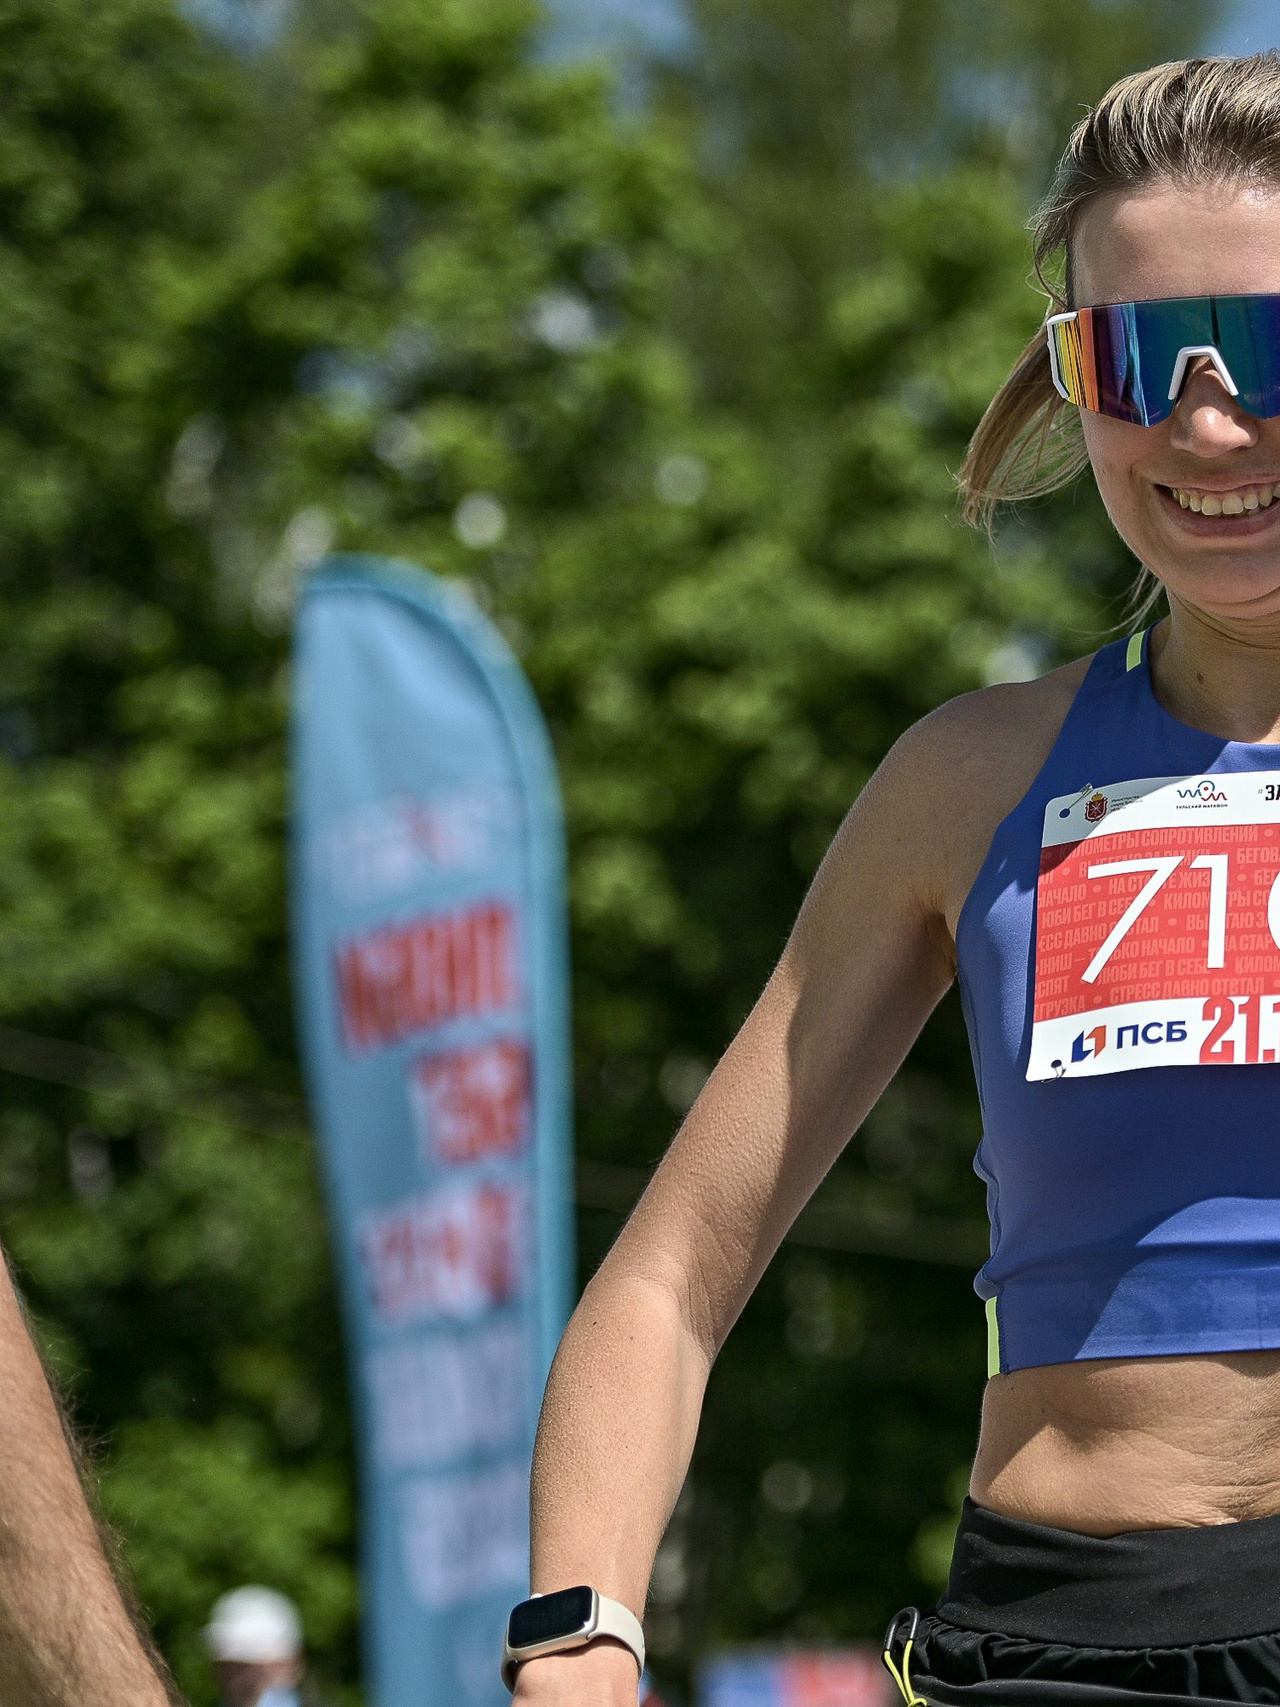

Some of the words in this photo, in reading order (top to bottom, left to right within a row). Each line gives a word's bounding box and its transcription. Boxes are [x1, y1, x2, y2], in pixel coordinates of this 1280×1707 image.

[1141, 824, 1258, 847] СОПРОТИВЛЕНИЙ
[1108, 876, 1127, 896] НА
[1073, 902, 1096, 922] БЕГ
[1097, 900, 1106, 918] В
[1063, 923, 1107, 949] ДАВНО
[1142, 936, 1195, 957] НАЧАЛО
[1139, 959, 1164, 978] БЕГ
[1165, 959, 1175, 976] В
[1109, 983, 1160, 1004] СТРЕСС
[1161, 978, 1210, 999] ДАВНО
[1116, 1020, 1188, 1050] ПСБ
